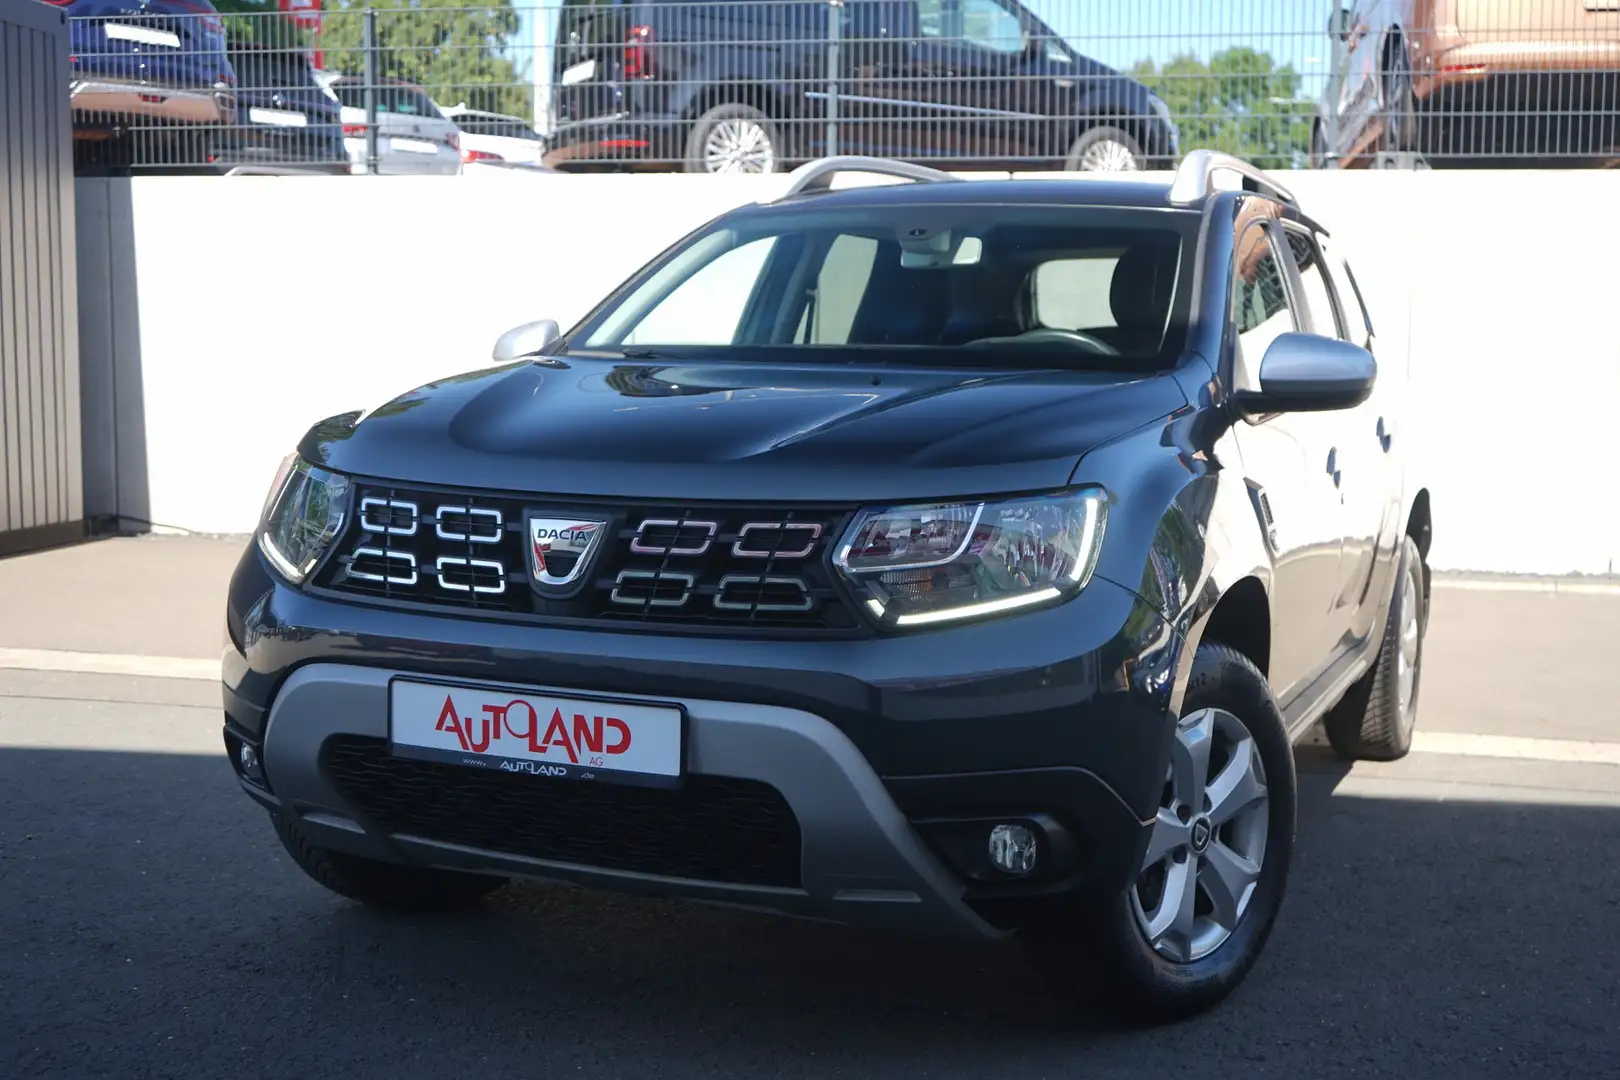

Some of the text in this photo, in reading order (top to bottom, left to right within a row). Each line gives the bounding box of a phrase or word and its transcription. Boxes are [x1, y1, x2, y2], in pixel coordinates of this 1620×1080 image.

[537, 528, 587, 541] DACIA
[435, 693, 631, 763] AUTOLAND
[500, 760, 567, 776] AUTOLAND
[590, 756, 603, 767] AG
